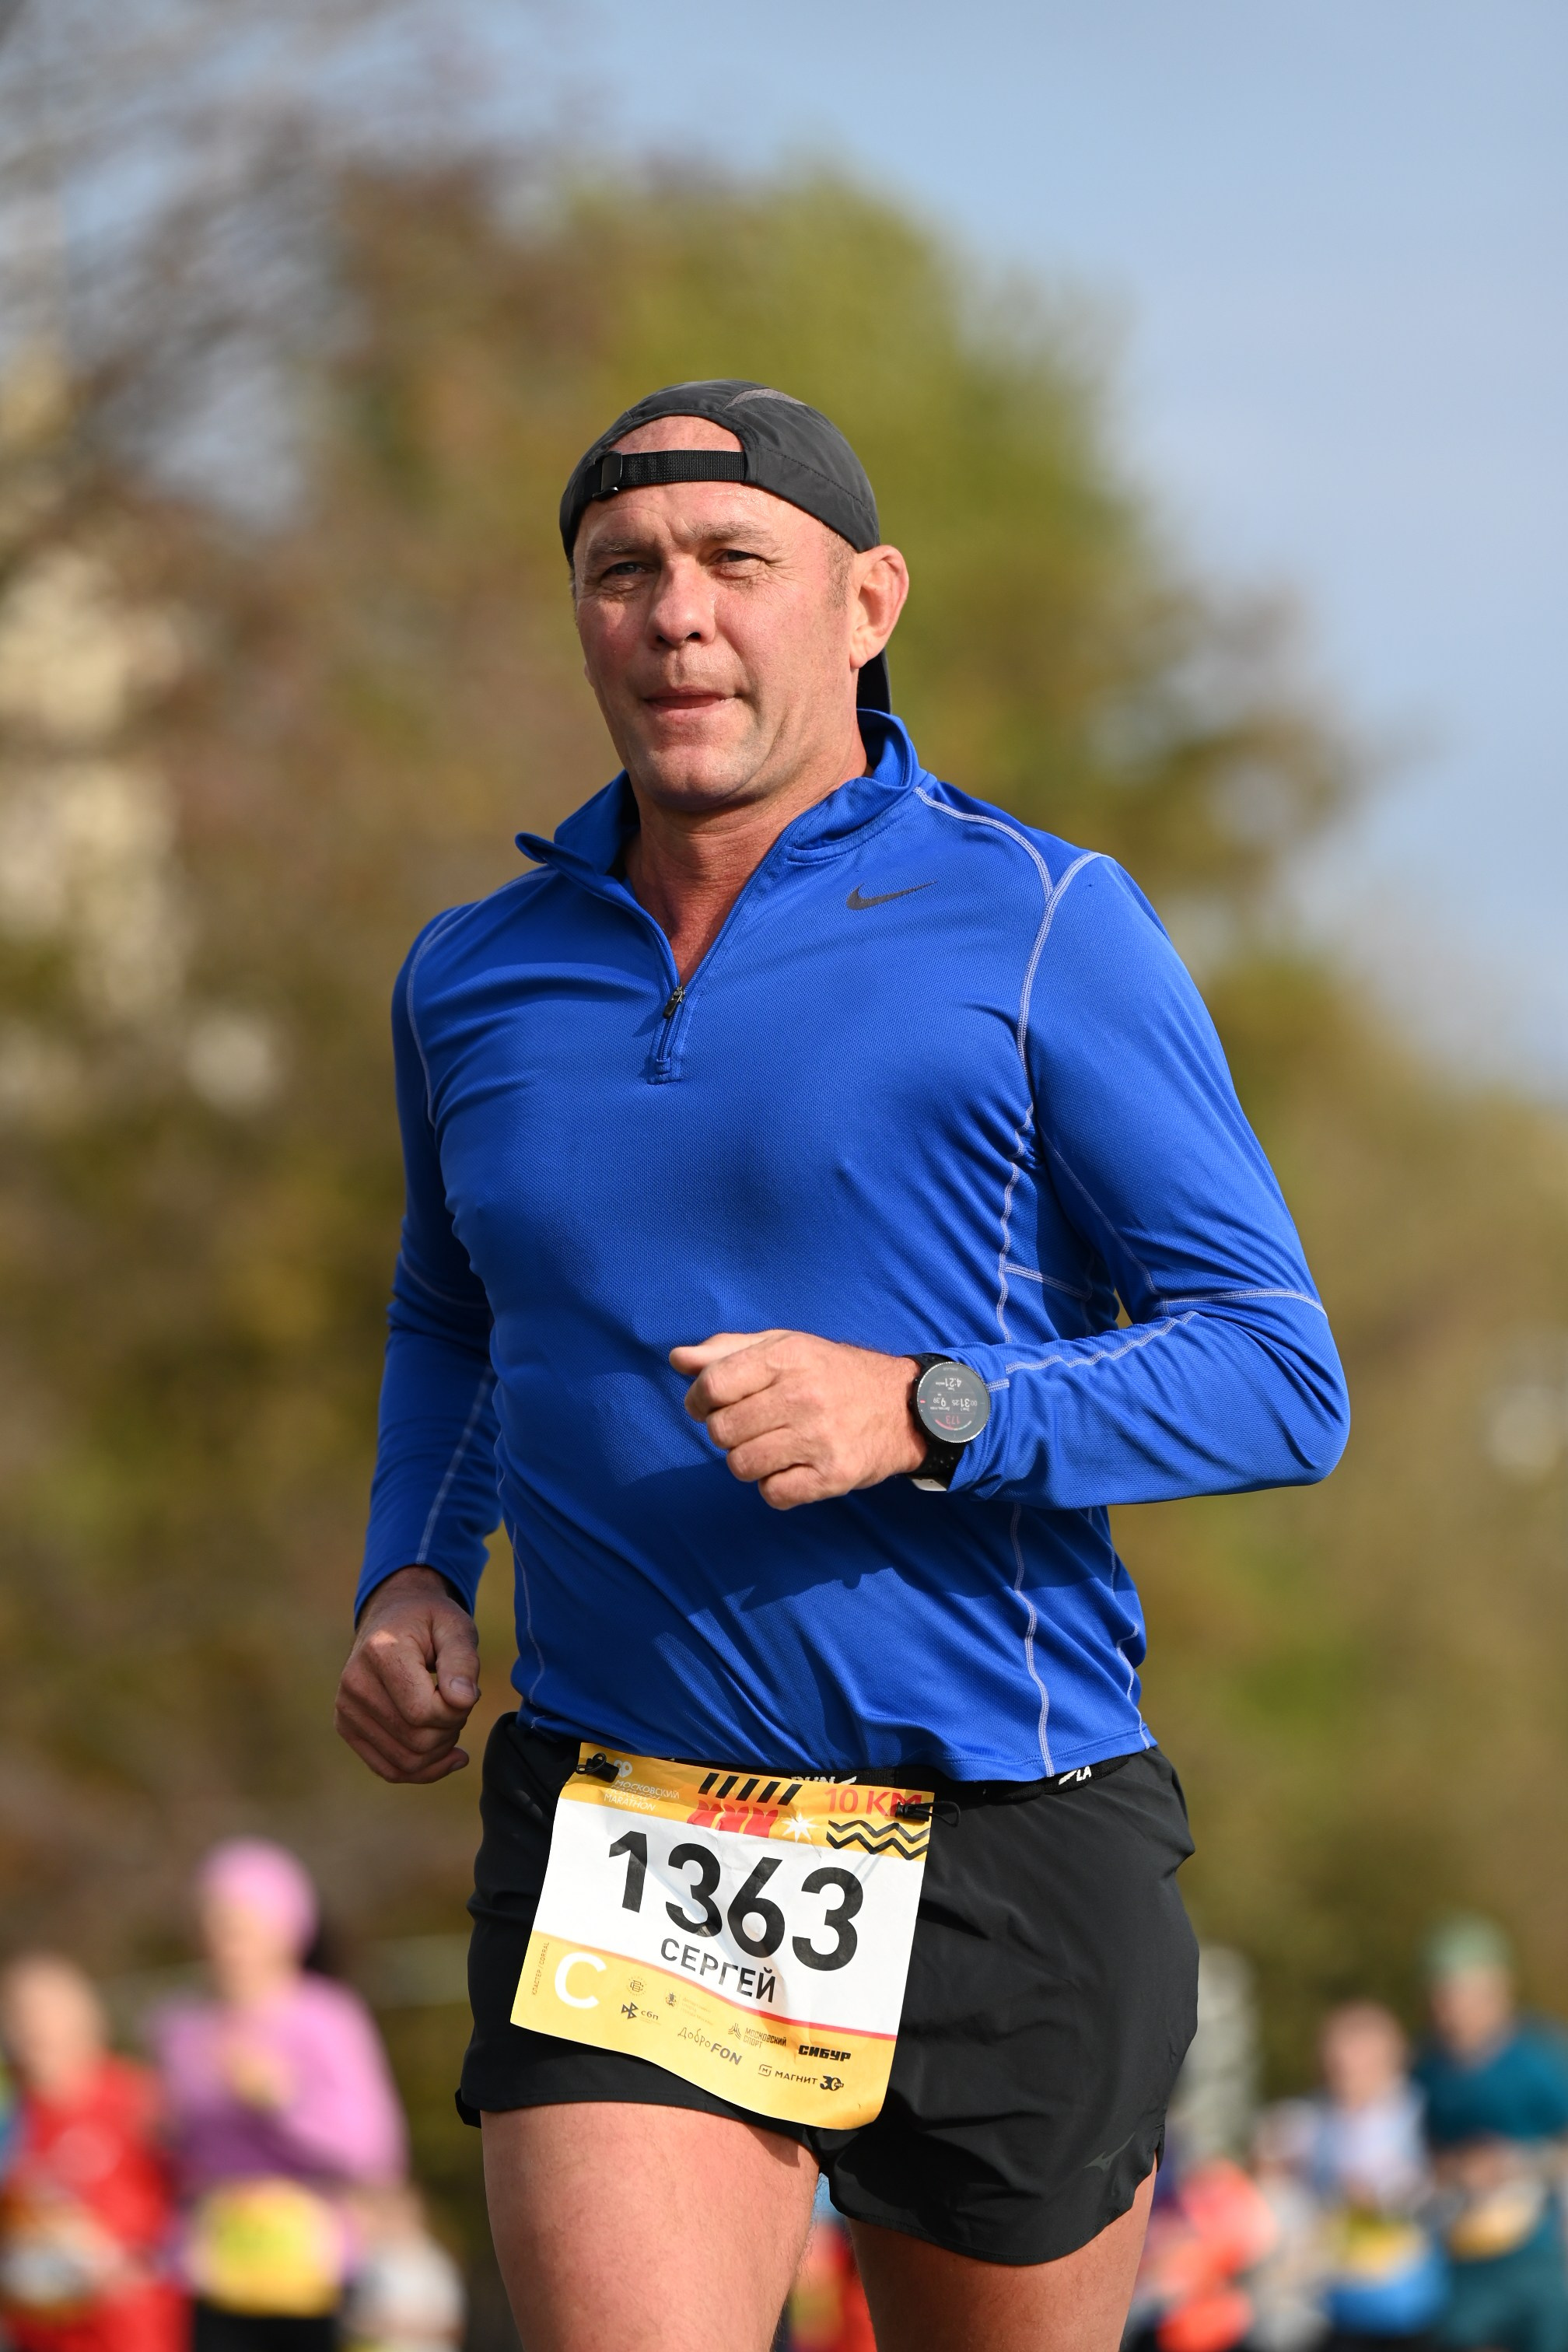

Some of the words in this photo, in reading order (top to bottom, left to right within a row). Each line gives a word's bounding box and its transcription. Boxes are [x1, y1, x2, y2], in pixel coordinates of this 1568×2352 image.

[945, 1378, 962, 1388] 4:21
[614, 1780, 681, 1800] МОСКОВСКИЙ
[604, 1793, 656, 1811] MARATHON
[824, 1787, 859, 1814] 10
[609, 1830, 863, 1971] 1363
[555, 1951, 607, 2009] C
[660, 1937, 776, 2004] СЕРГЕЙ
[743, 2035, 763, 2049] СПОРТ
[745, 2027, 787, 2047] МОСКОВСКИЙ
[798, 2045, 852, 2062] СИБУР
[775, 2070, 818, 2085] МАГНИТ
